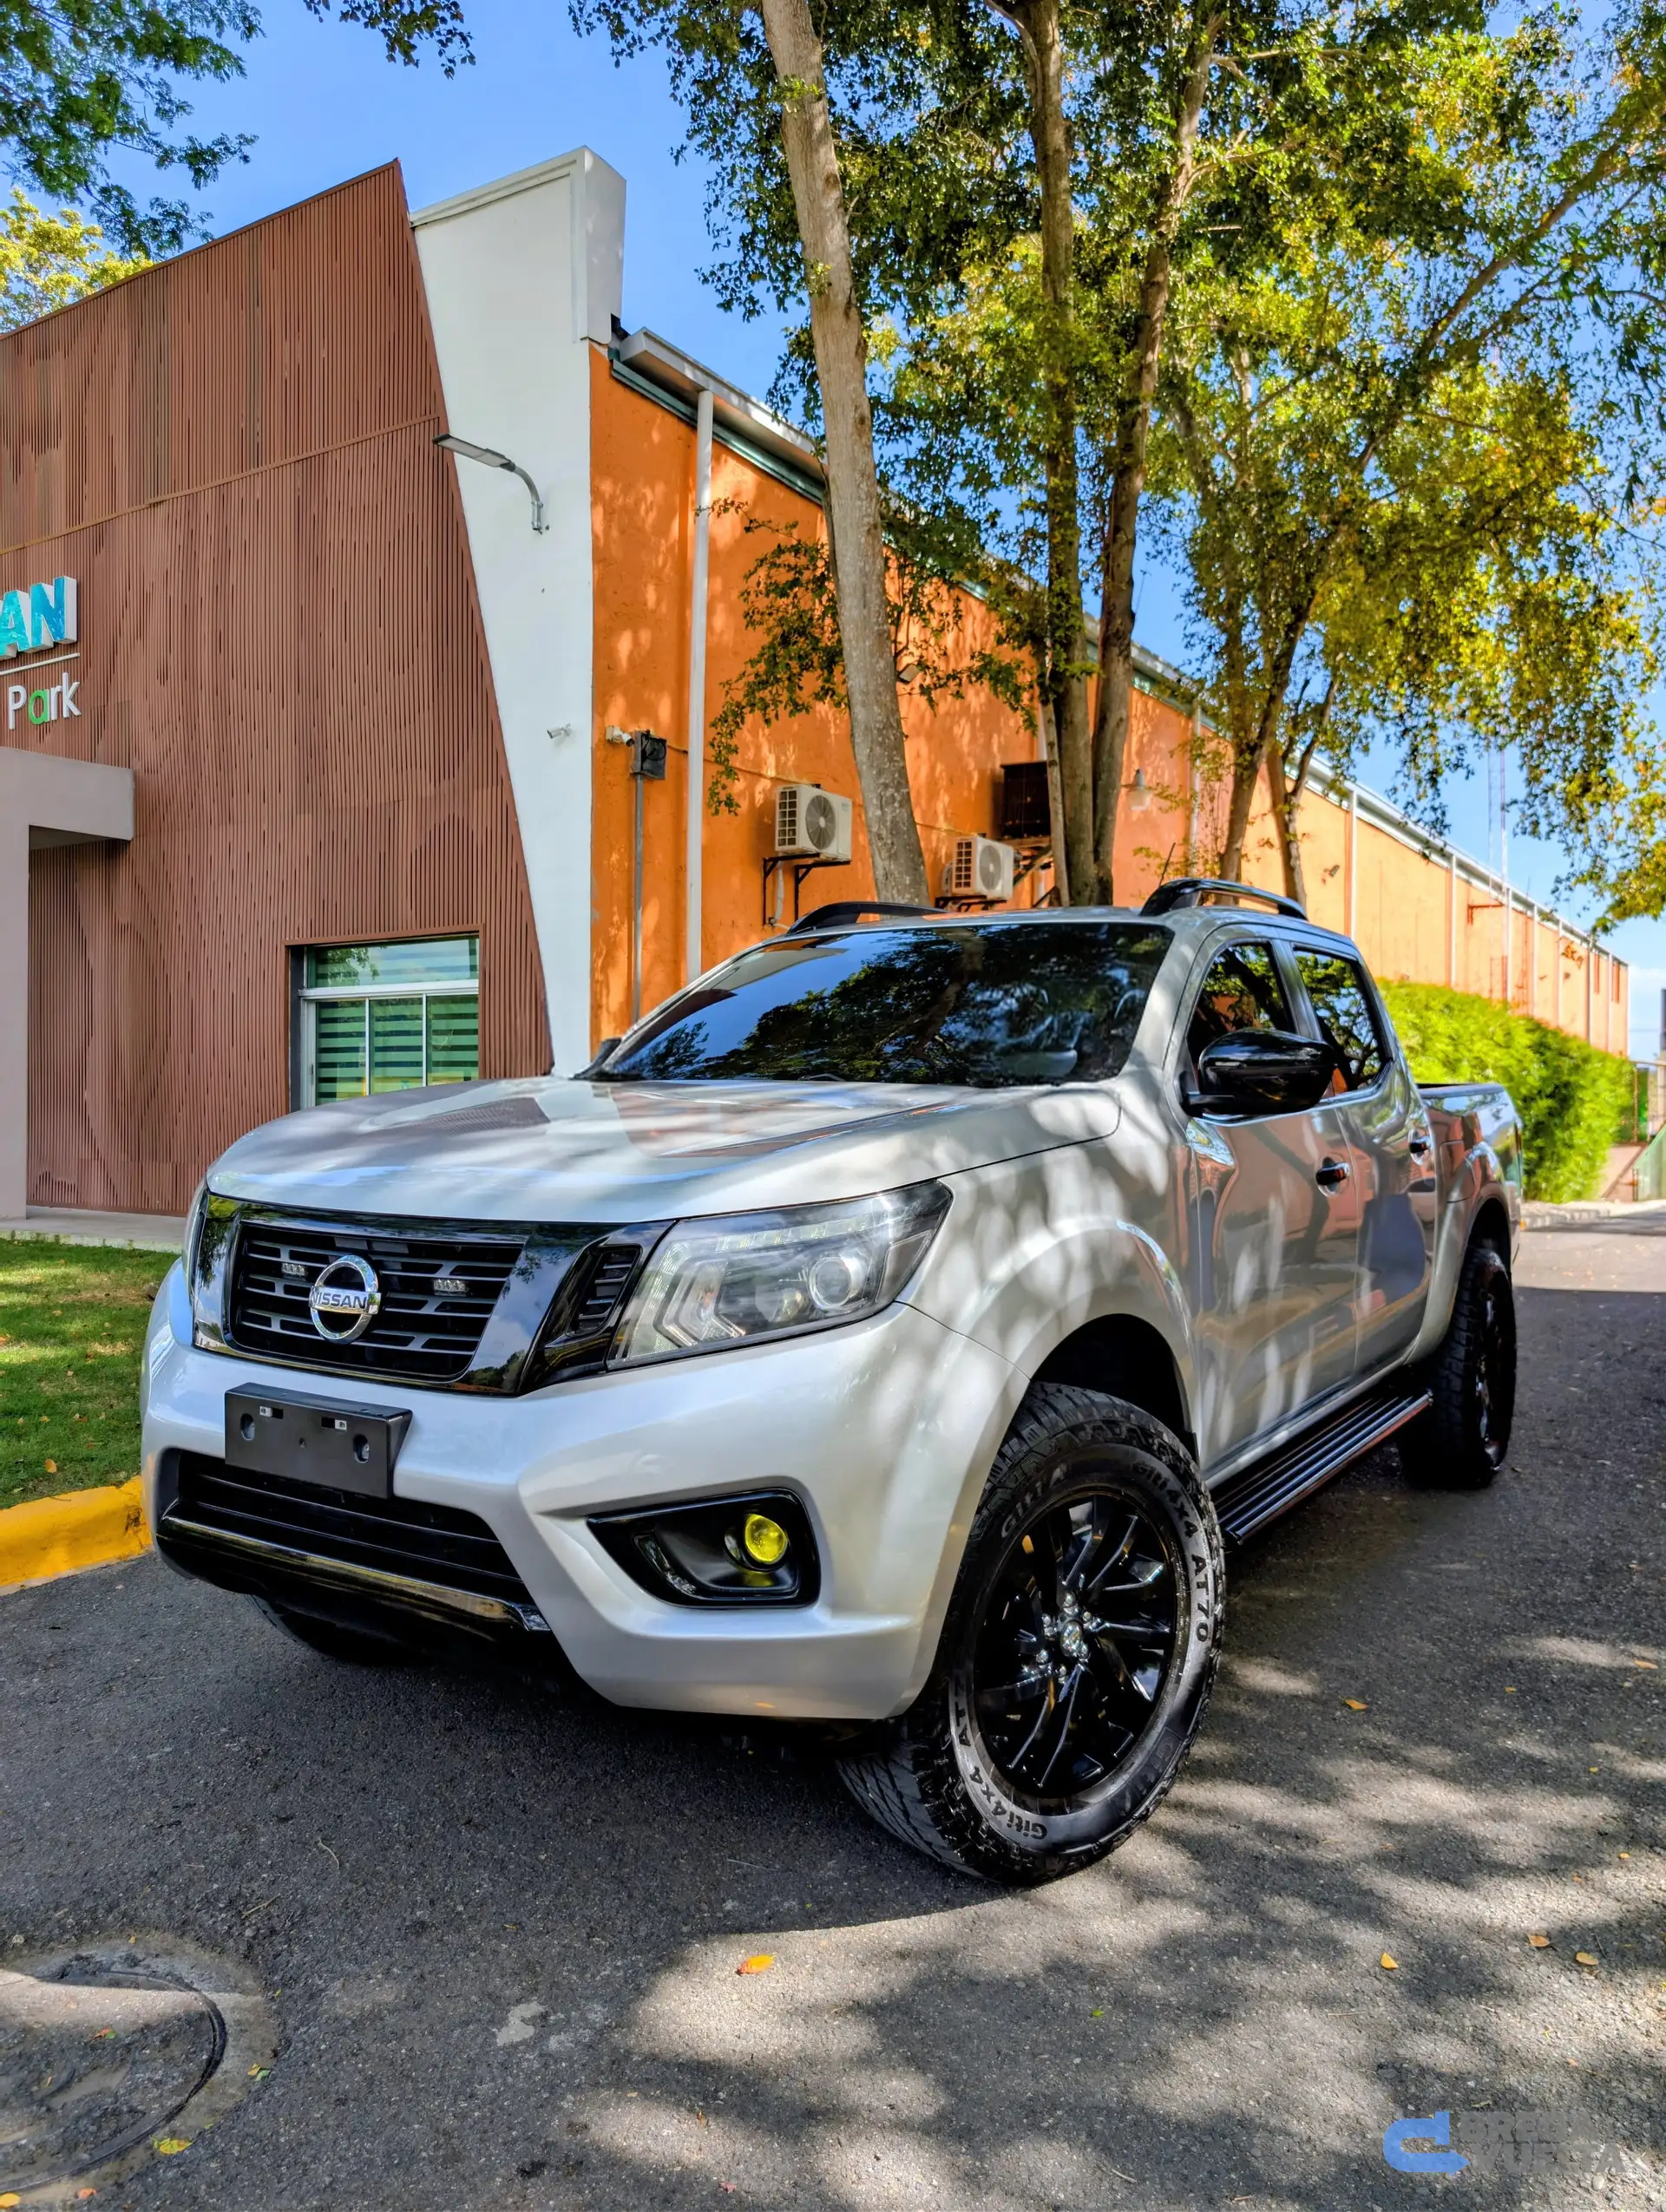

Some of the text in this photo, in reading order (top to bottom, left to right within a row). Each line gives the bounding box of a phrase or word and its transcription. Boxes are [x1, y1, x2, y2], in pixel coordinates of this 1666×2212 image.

[0, 576, 73, 658] AN
[9, 672, 82, 730] Park
[312, 1291, 368, 1310] NISSAN
[1190, 1554, 1210, 1643] AT70
